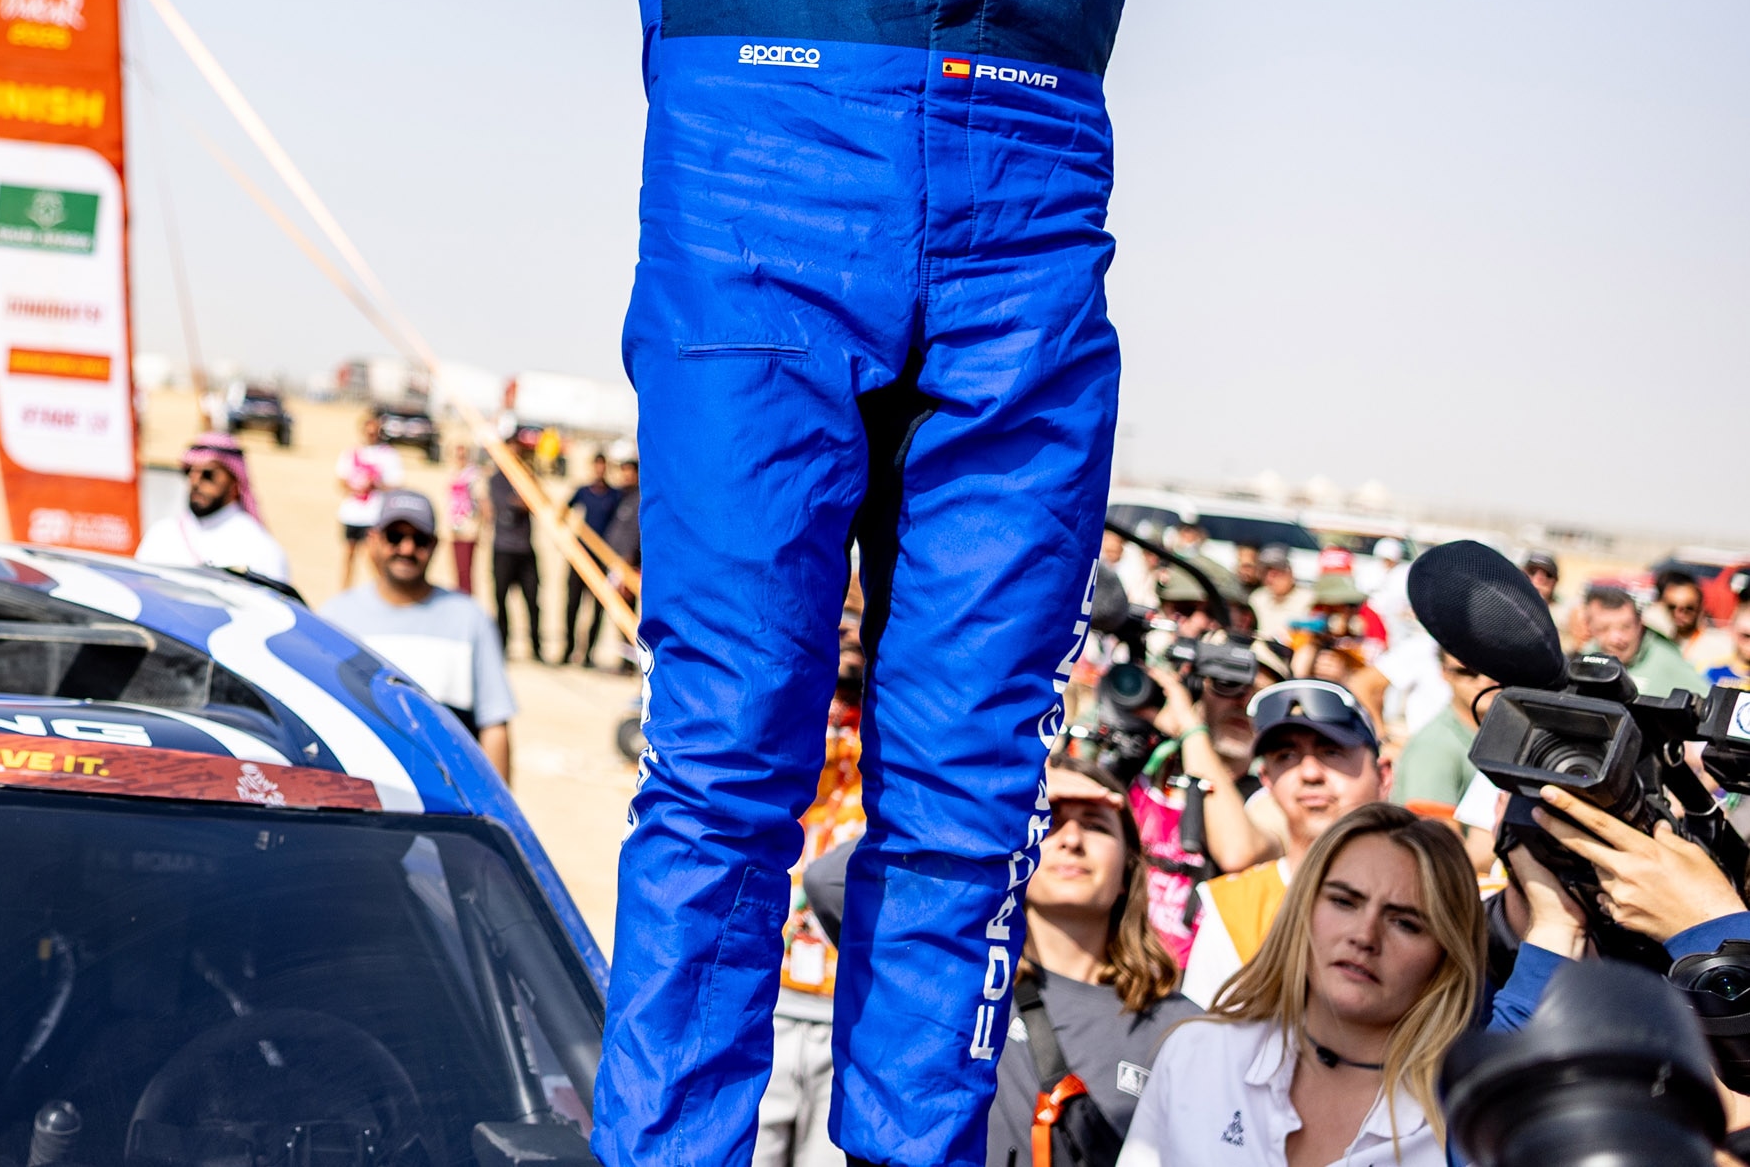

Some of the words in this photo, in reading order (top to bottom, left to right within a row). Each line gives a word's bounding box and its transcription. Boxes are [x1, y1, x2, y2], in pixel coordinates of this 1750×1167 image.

[738, 43, 821, 69] sparco
[975, 64, 1059, 89] ROMA
[63, 754, 110, 777] IT.
